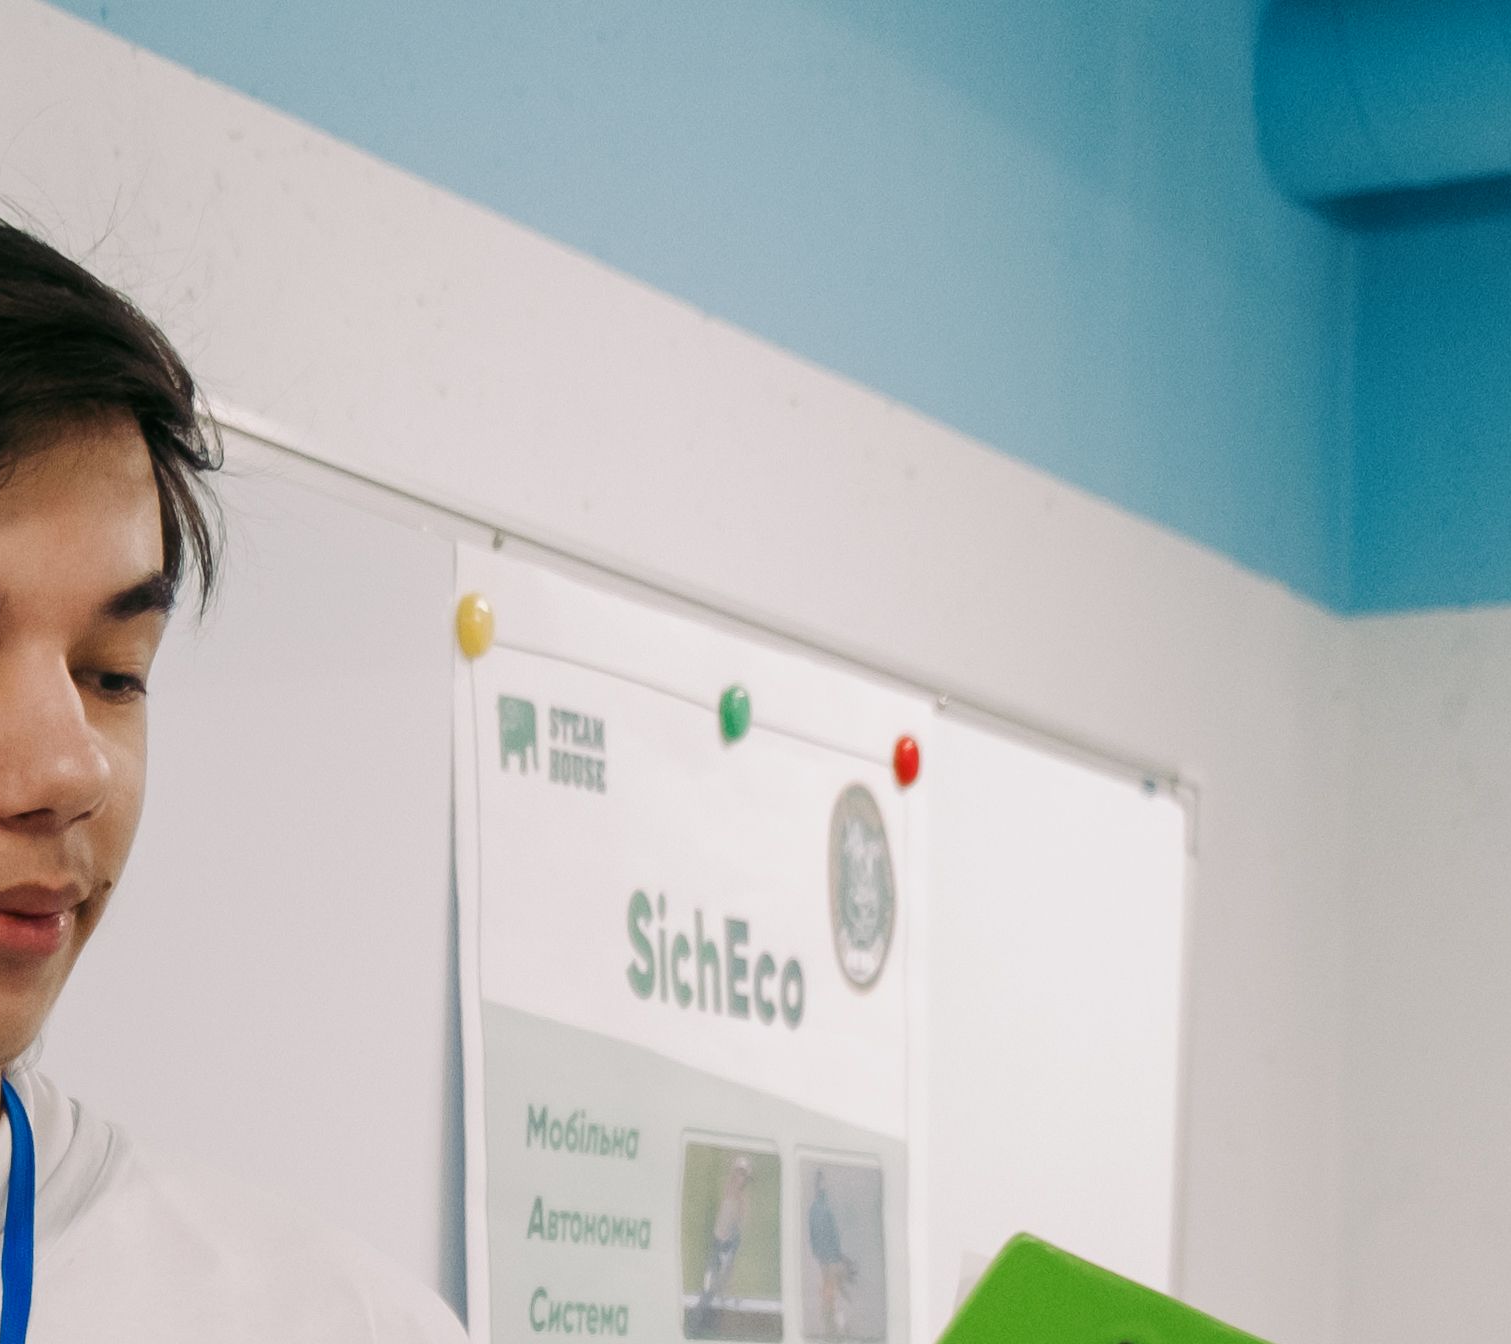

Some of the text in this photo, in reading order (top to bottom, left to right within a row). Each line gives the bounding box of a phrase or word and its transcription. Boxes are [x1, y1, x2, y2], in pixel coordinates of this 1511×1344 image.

[626, 889, 804, 1030] SichEco
[527, 1103, 640, 1160] Мобільна
[527, 1196, 651, 1250] Автономна
[529, 1287, 629, 1336] Система
